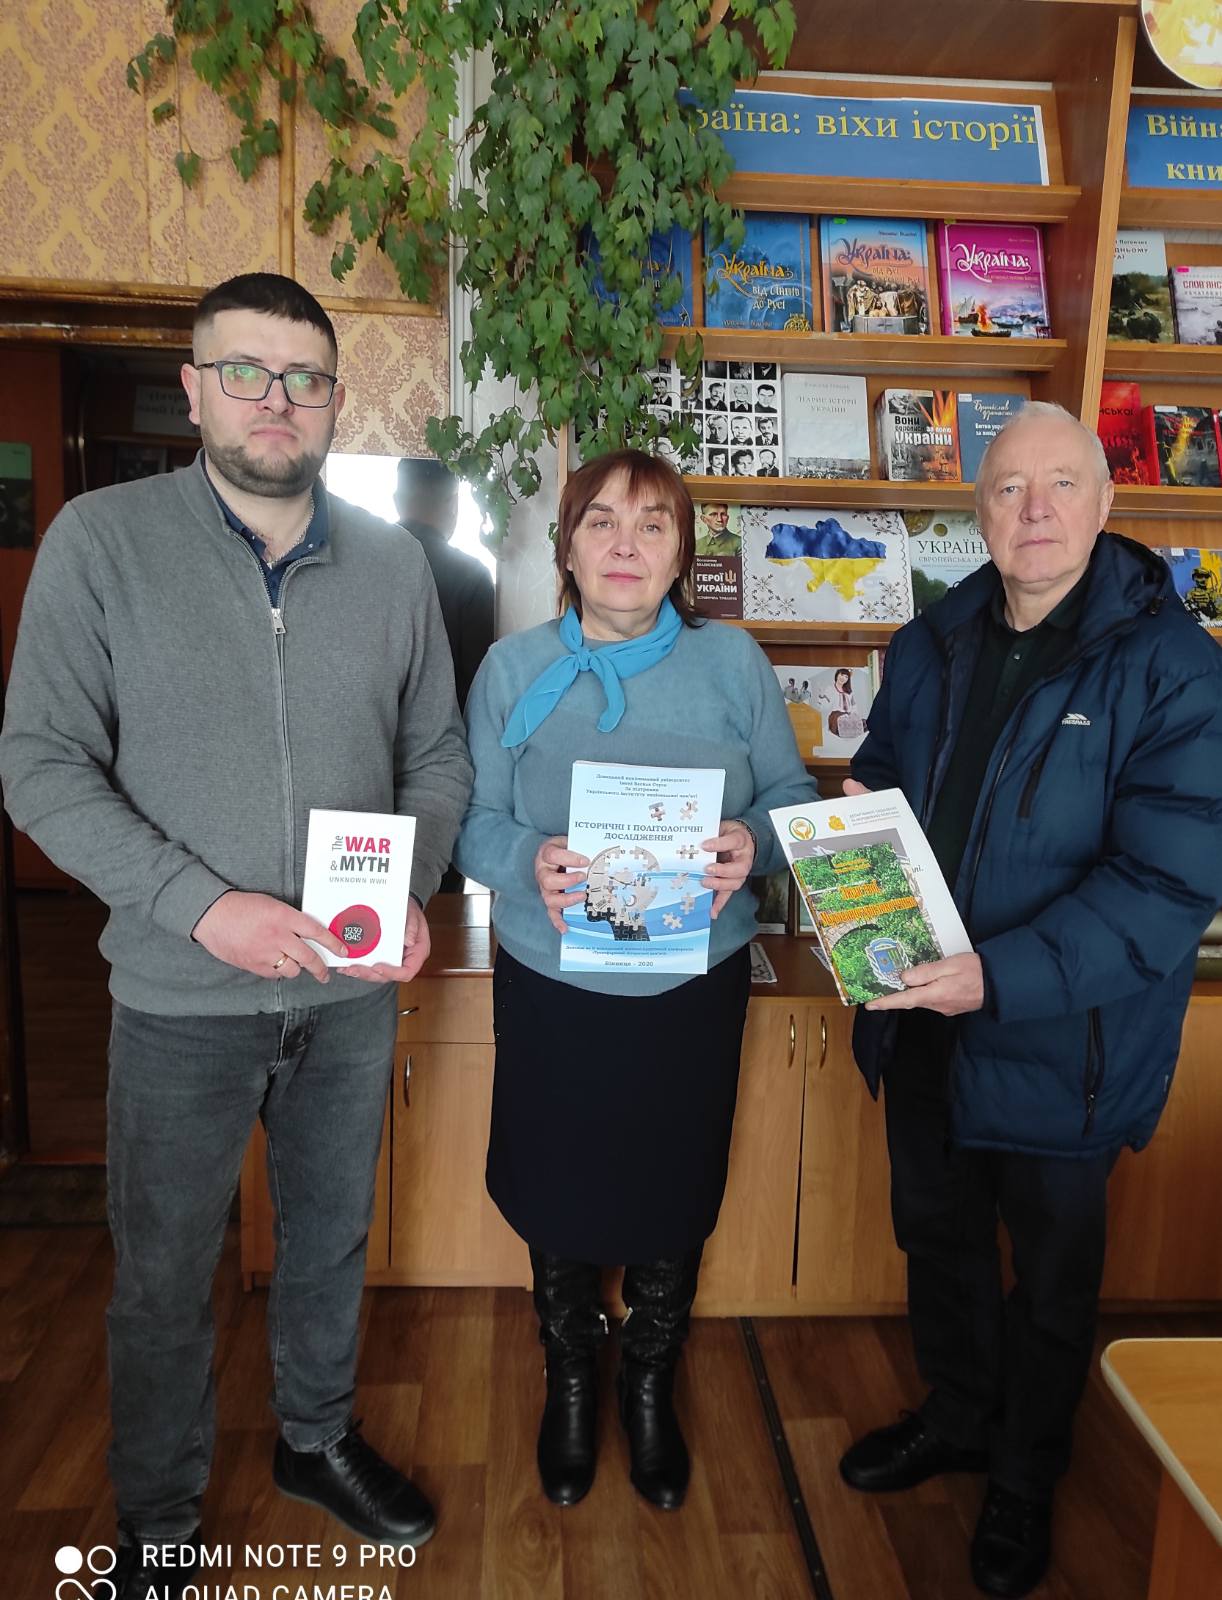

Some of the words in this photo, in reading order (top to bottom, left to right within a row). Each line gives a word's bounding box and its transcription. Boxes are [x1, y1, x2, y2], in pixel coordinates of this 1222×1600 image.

[690, 103, 800, 137] раїна:
[816, 106, 899, 138] віхи
[911, 109, 1038, 151] історії
[895, 415, 920, 425] Вони
[894, 431, 953, 446] України
[917, 539, 989, 554] УКРАЇН
[696, 572, 724, 582] ГЕРОЇ
[696, 583, 738, 593] УКРАЇНИ
[575, 821, 624, 831] ІСТОРИЧНІ
[633, 824, 704, 833] ПОЛІТОЛОГІЧНІ
[603, 832, 674, 842] ДОСЛІДЖЕННЯ
[332, 835, 344, 852] The
[345, 836, 392, 854] WAR
[330, 860, 338, 871] &
[339, 855, 390, 873] MYTH
[329, 876, 367, 884] UNKNOWN
[369, 877, 388, 886] WWII
[344, 926, 363, 935] 1939
[343, 933, 362, 942] 1945
